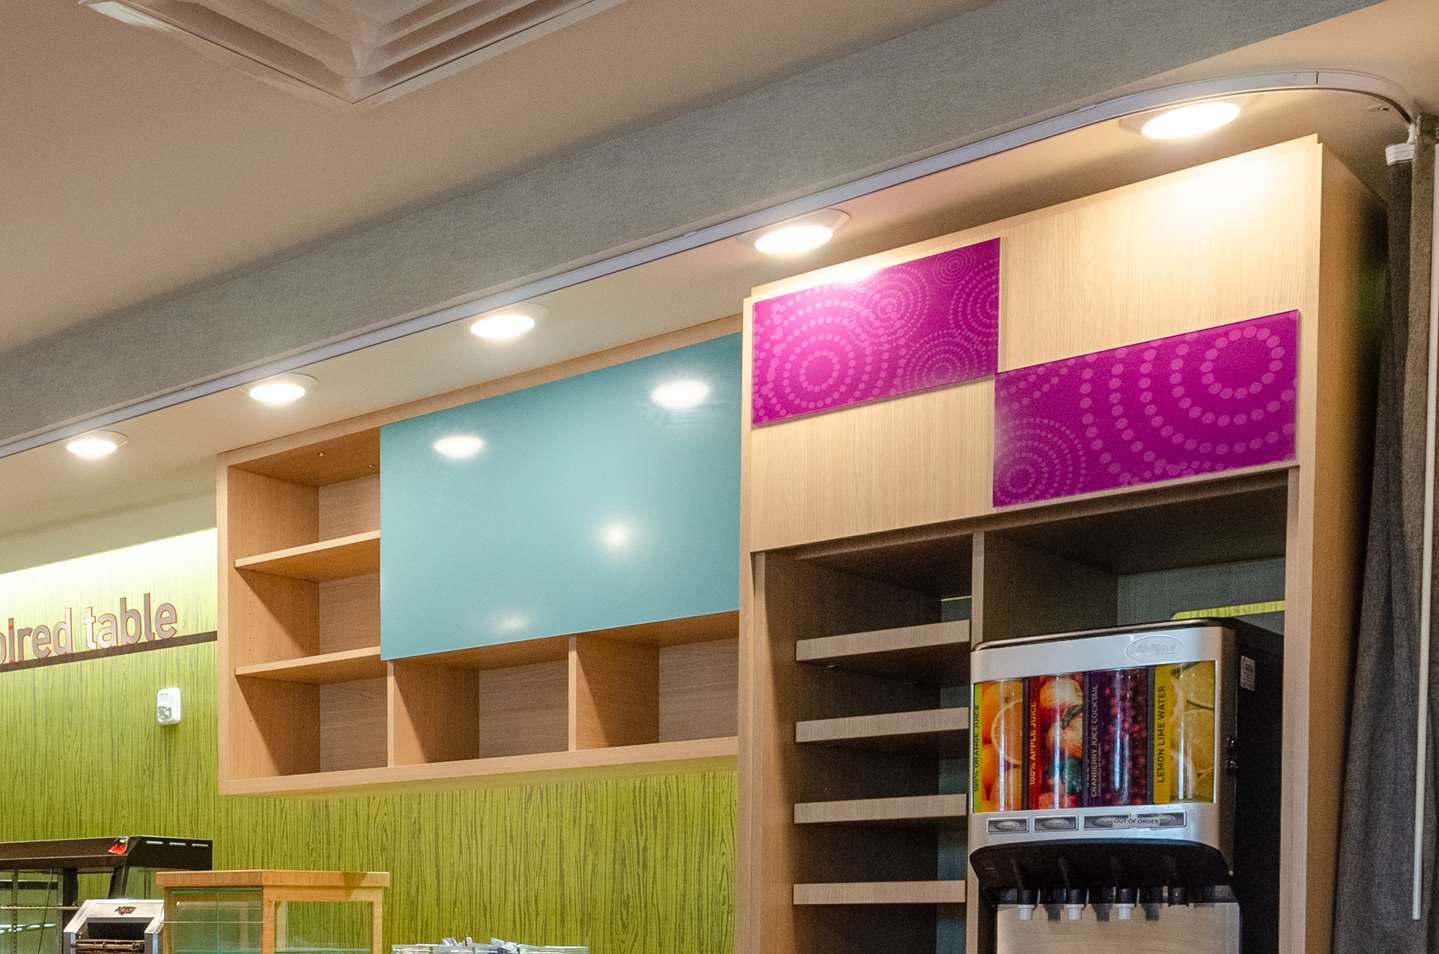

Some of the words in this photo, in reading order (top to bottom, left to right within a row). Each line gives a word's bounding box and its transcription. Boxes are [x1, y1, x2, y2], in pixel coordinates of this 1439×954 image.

[84, 592, 178, 650] table
[1090, 684, 1098, 723] COCKTAIL
[1157, 685, 1165, 720] WATER
[1090, 725, 1098, 748] JUICE
[1157, 722, 1165, 746] LIME
[1090, 750, 1098, 797] CRANBERRY
[1157, 748, 1165, 783] LEMON
